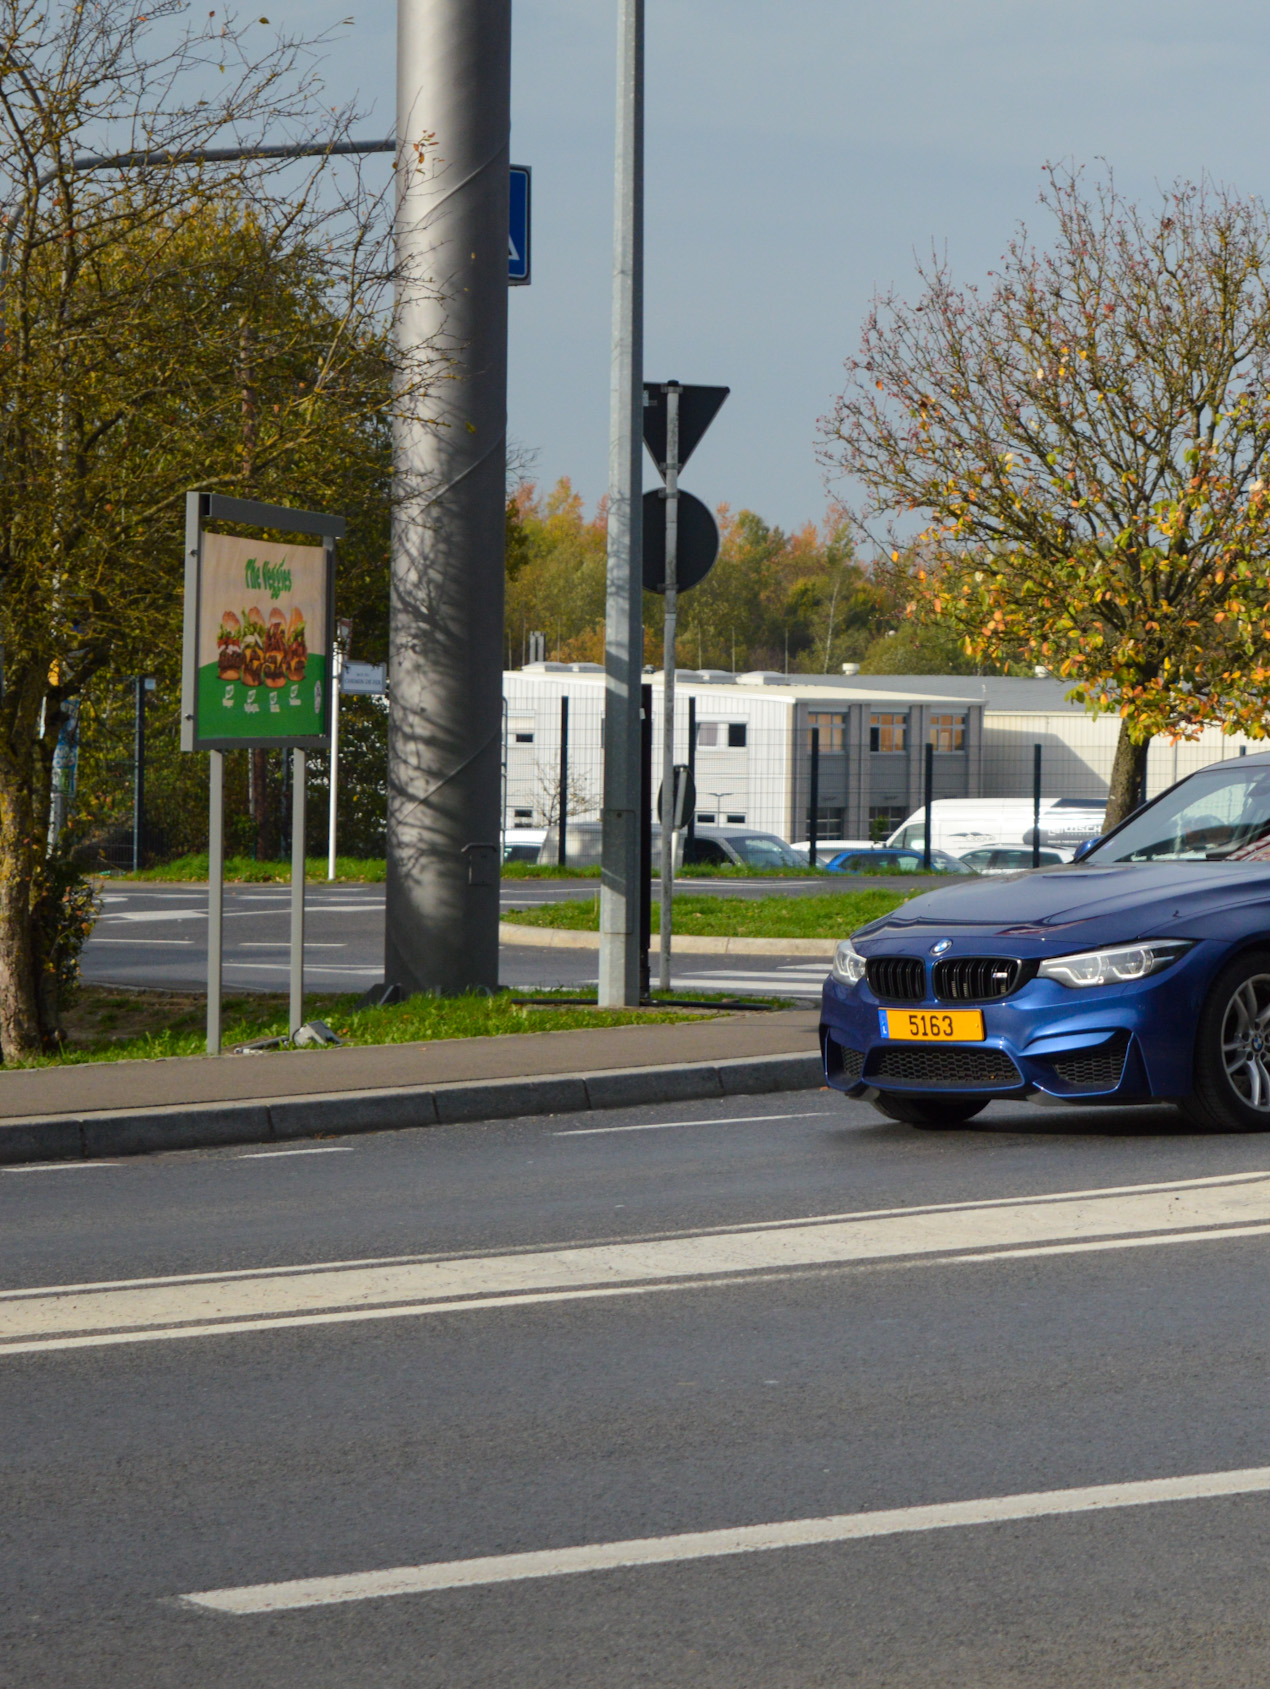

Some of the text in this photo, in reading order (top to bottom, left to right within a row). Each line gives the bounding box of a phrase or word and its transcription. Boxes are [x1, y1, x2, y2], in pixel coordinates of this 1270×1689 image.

[245, 553, 292, 600] The Veggies
[908, 1014, 954, 1037] 5163
